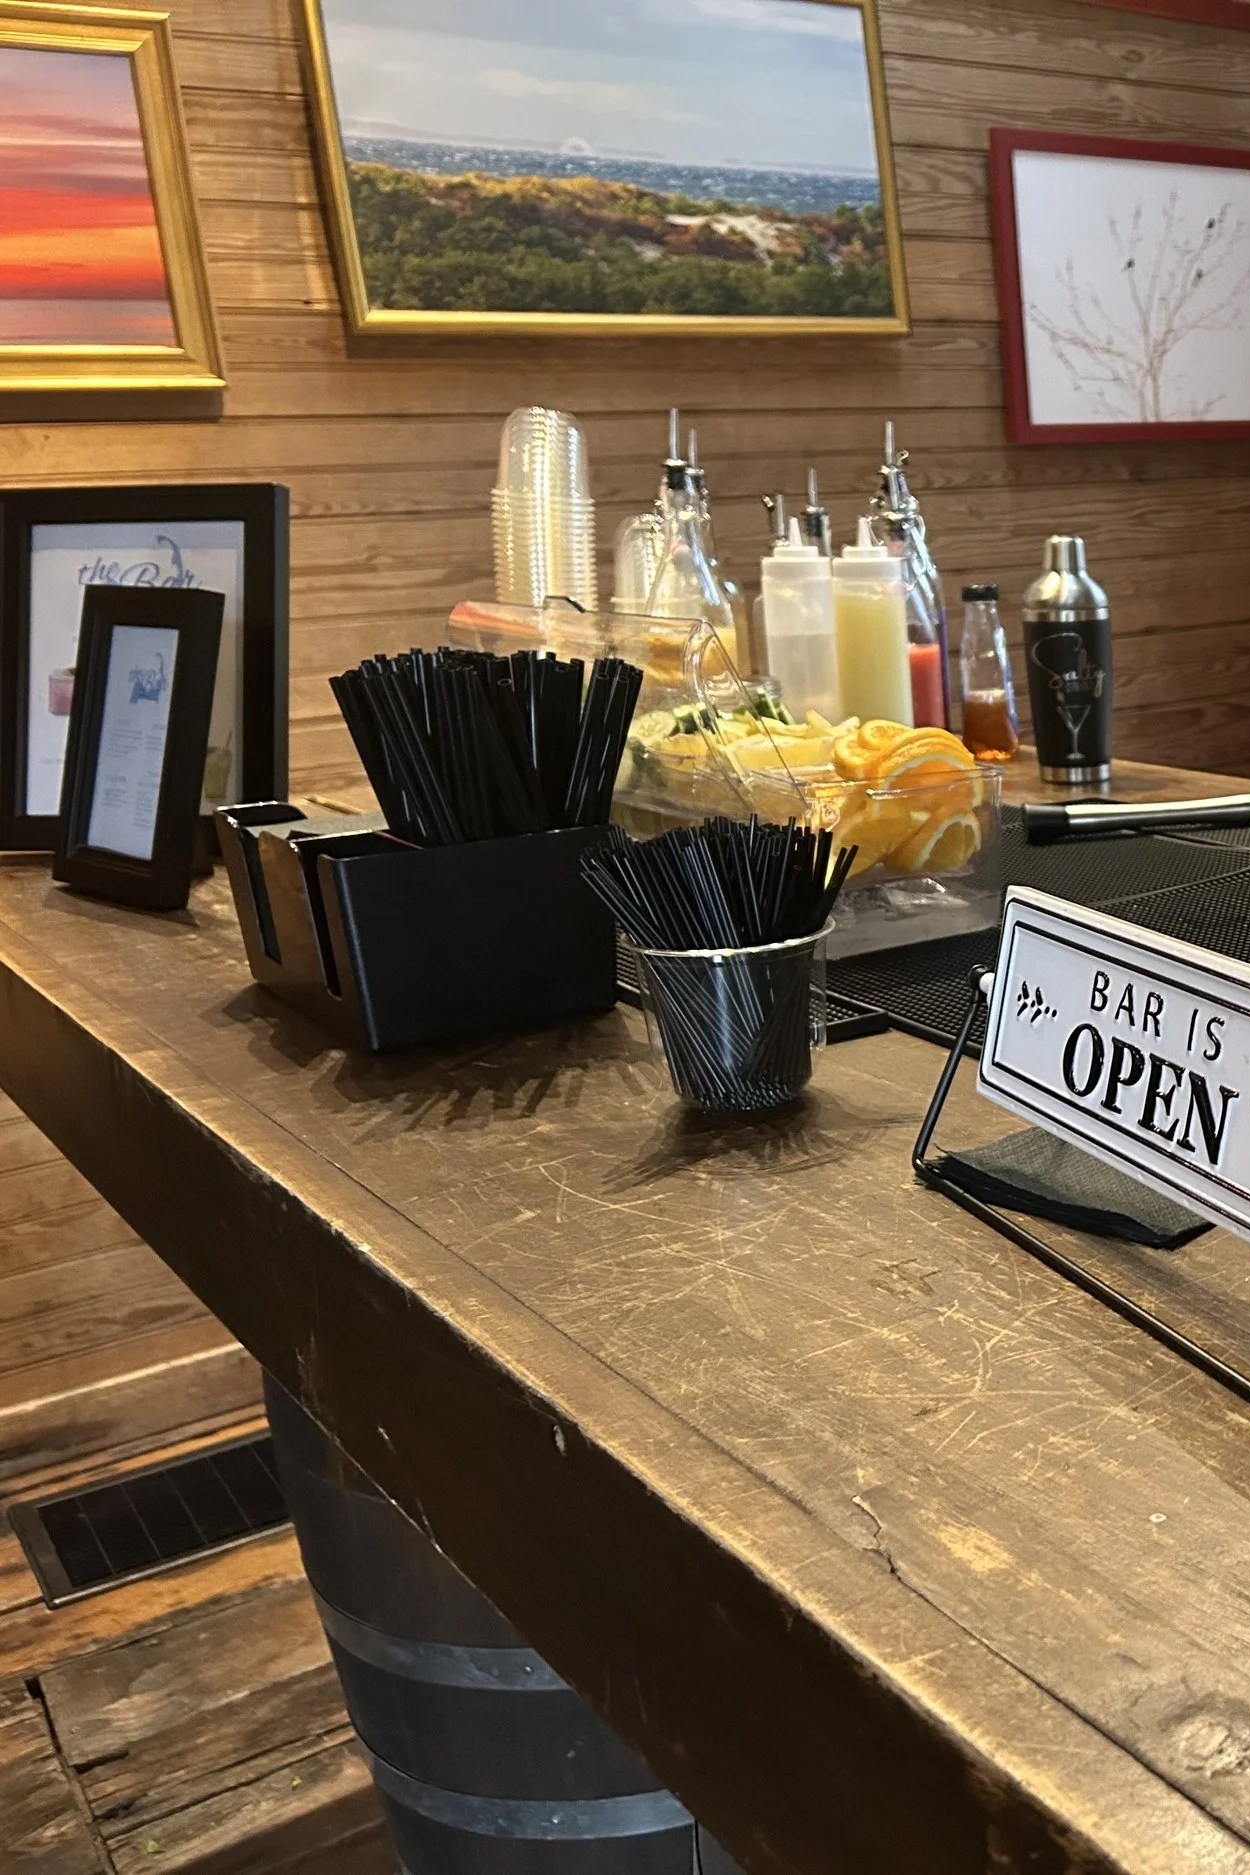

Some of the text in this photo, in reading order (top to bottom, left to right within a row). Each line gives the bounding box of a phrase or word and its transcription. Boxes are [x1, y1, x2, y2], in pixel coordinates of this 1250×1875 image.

[1090, 970, 1226, 1062] BAR IS
[1062, 1023, 1240, 1166] OPEN
